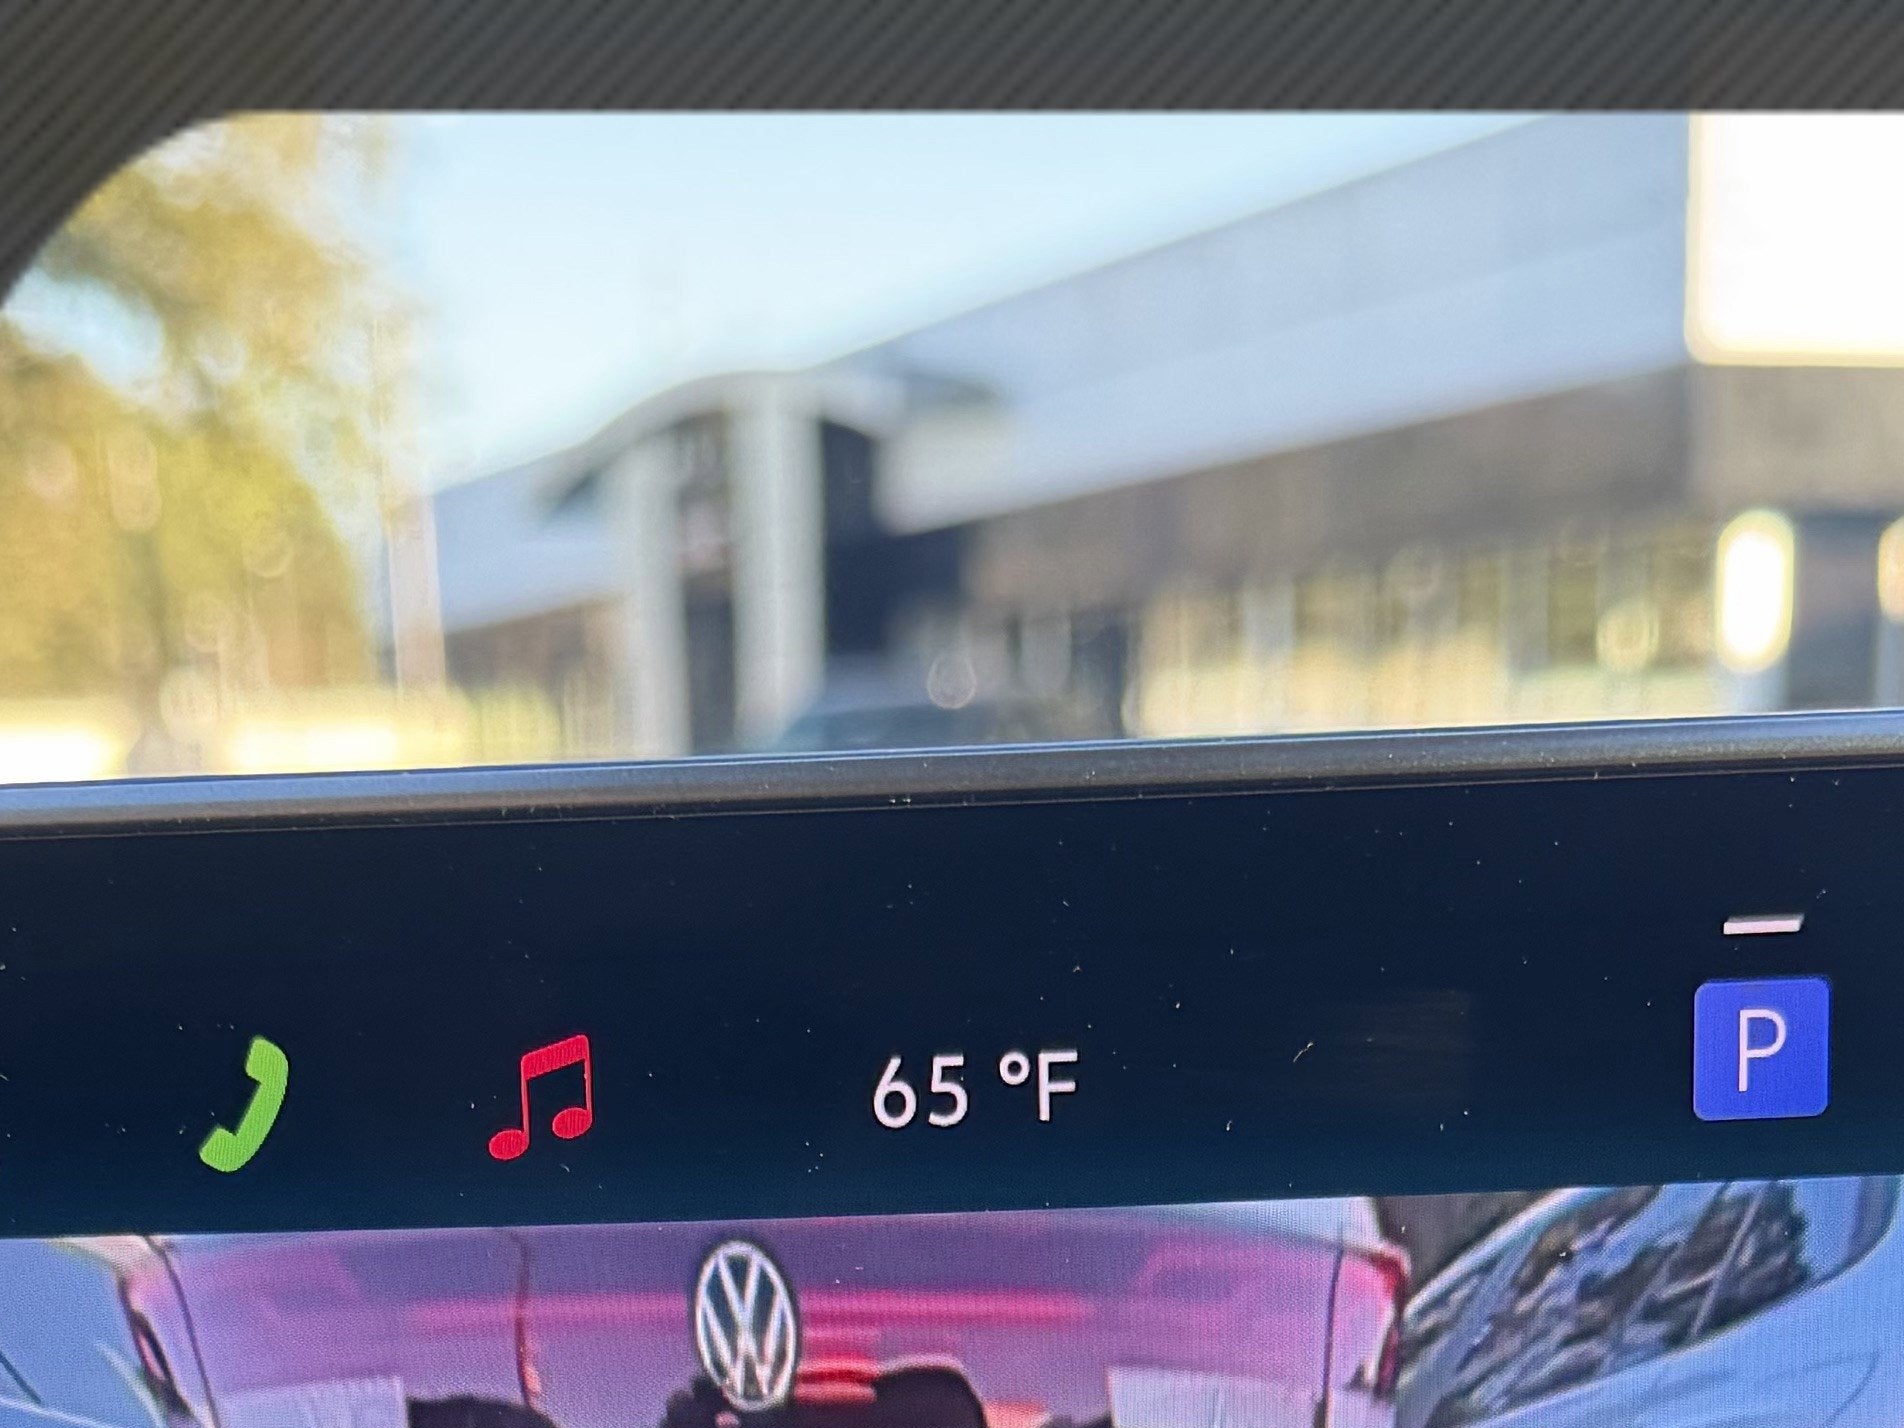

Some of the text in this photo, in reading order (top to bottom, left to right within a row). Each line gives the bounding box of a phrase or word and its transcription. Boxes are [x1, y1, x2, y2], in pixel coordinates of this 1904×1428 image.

[872, 1049, 1079, 1128] 65 °F
[1737, 1008, 1787, 1092] P
